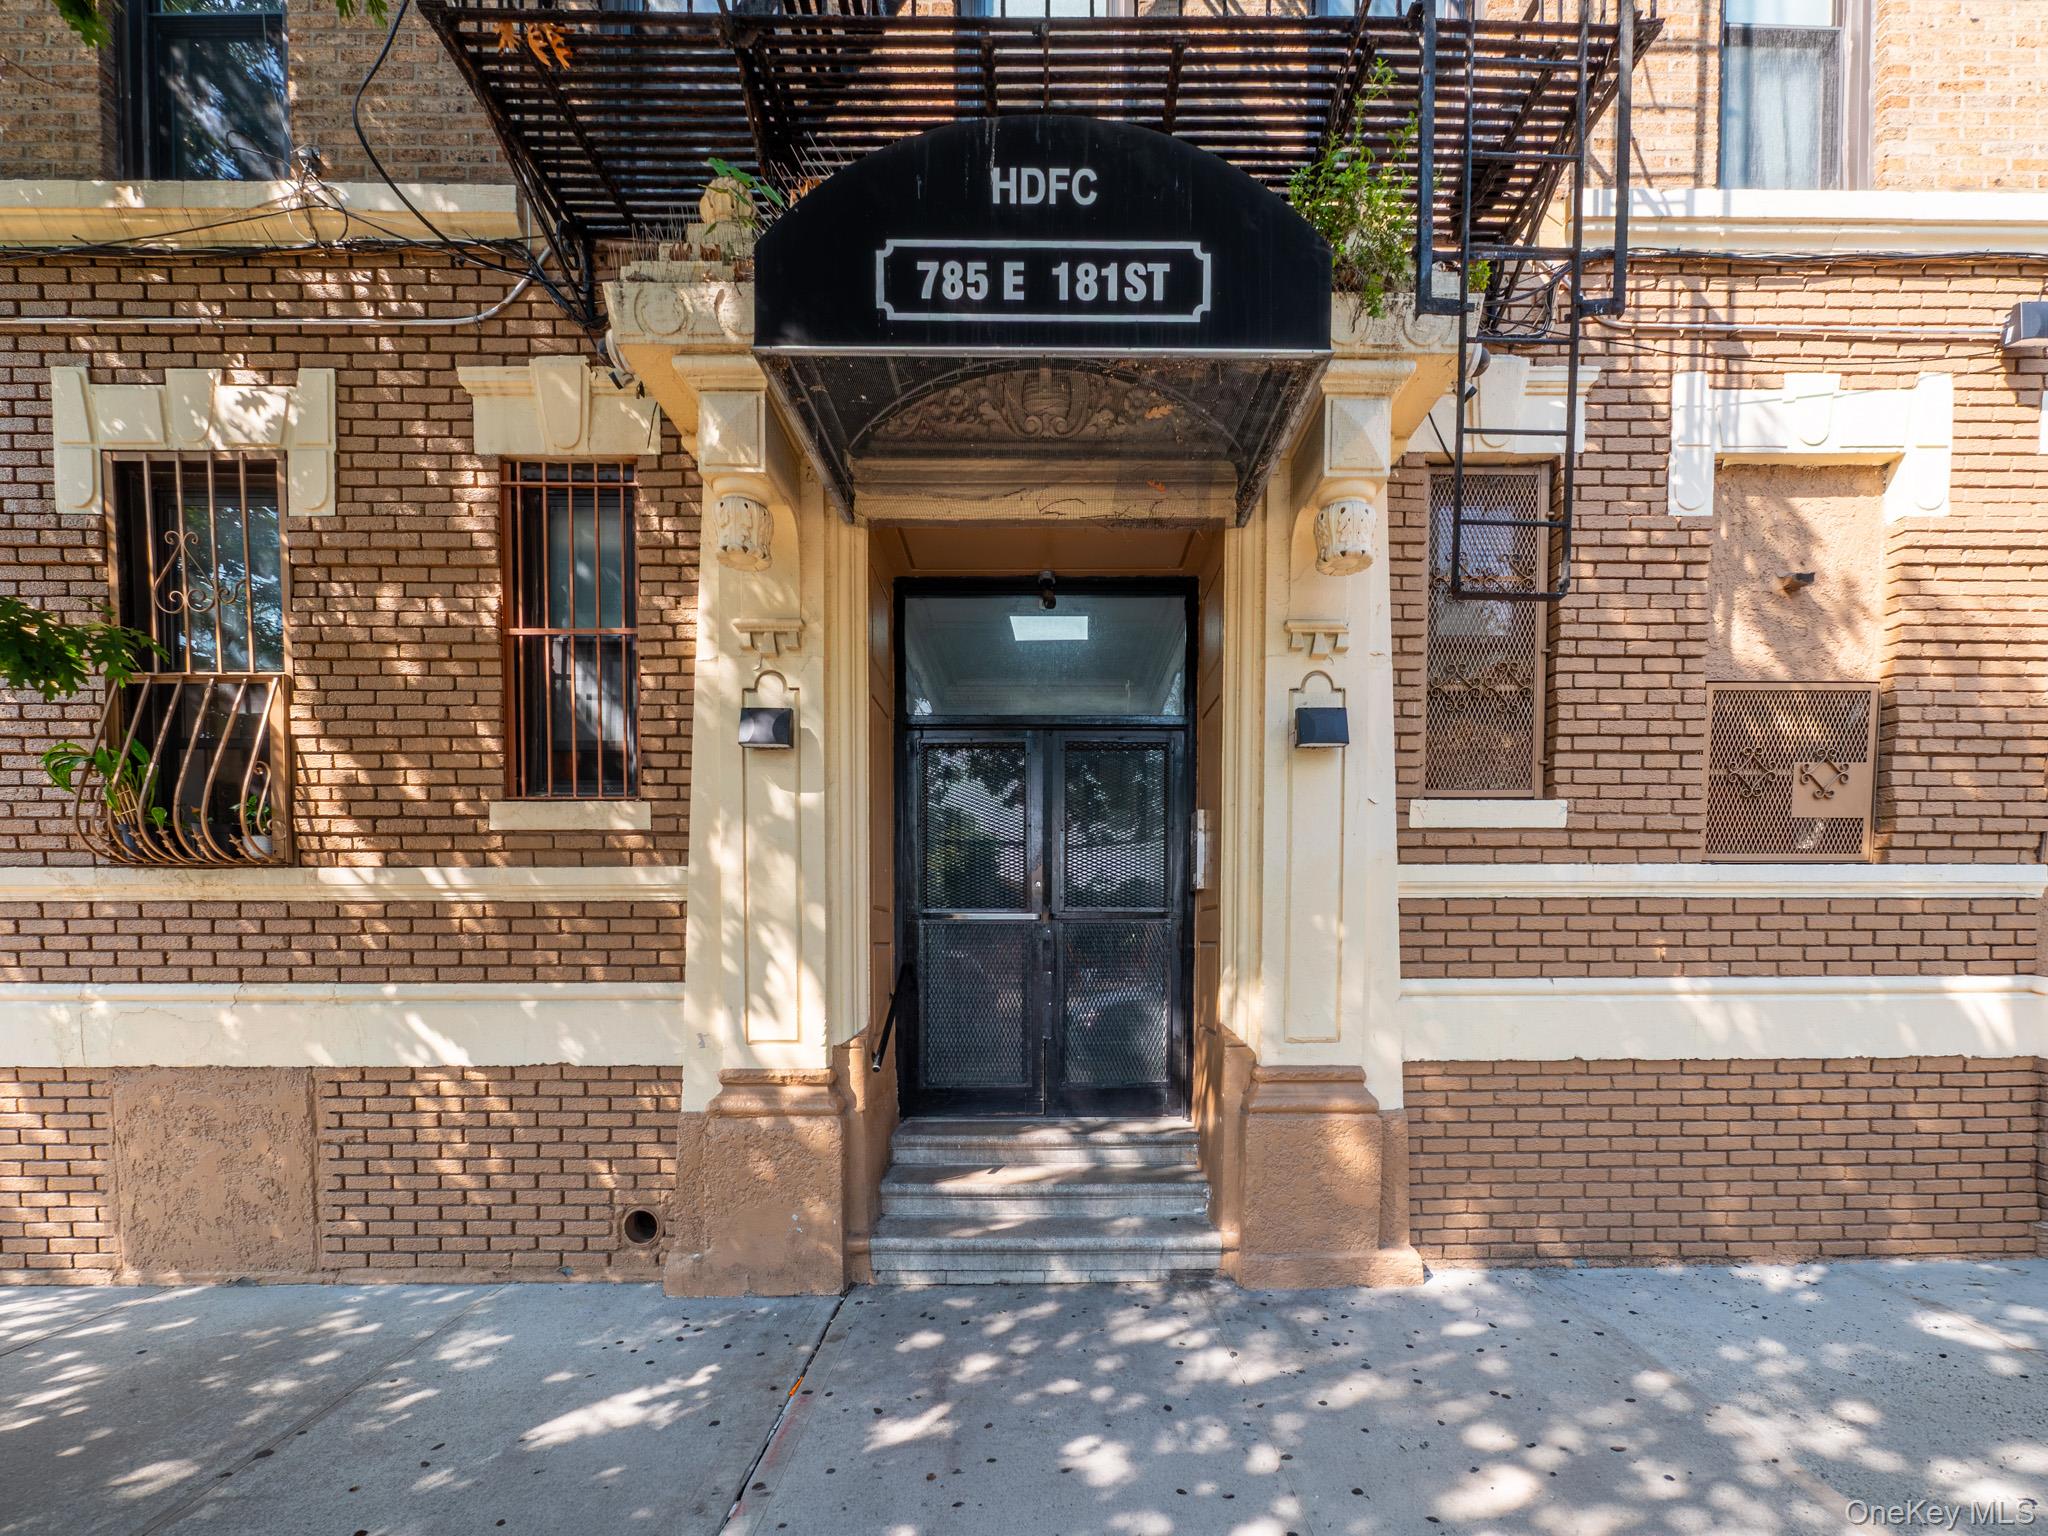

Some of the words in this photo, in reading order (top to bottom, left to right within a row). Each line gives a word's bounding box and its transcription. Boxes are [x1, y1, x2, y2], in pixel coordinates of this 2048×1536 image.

[991, 167, 1098, 206] HDFC
[916, 261, 989, 301] 785
[1003, 261, 1025, 301] E
[1052, 262, 1171, 302] 181ST
